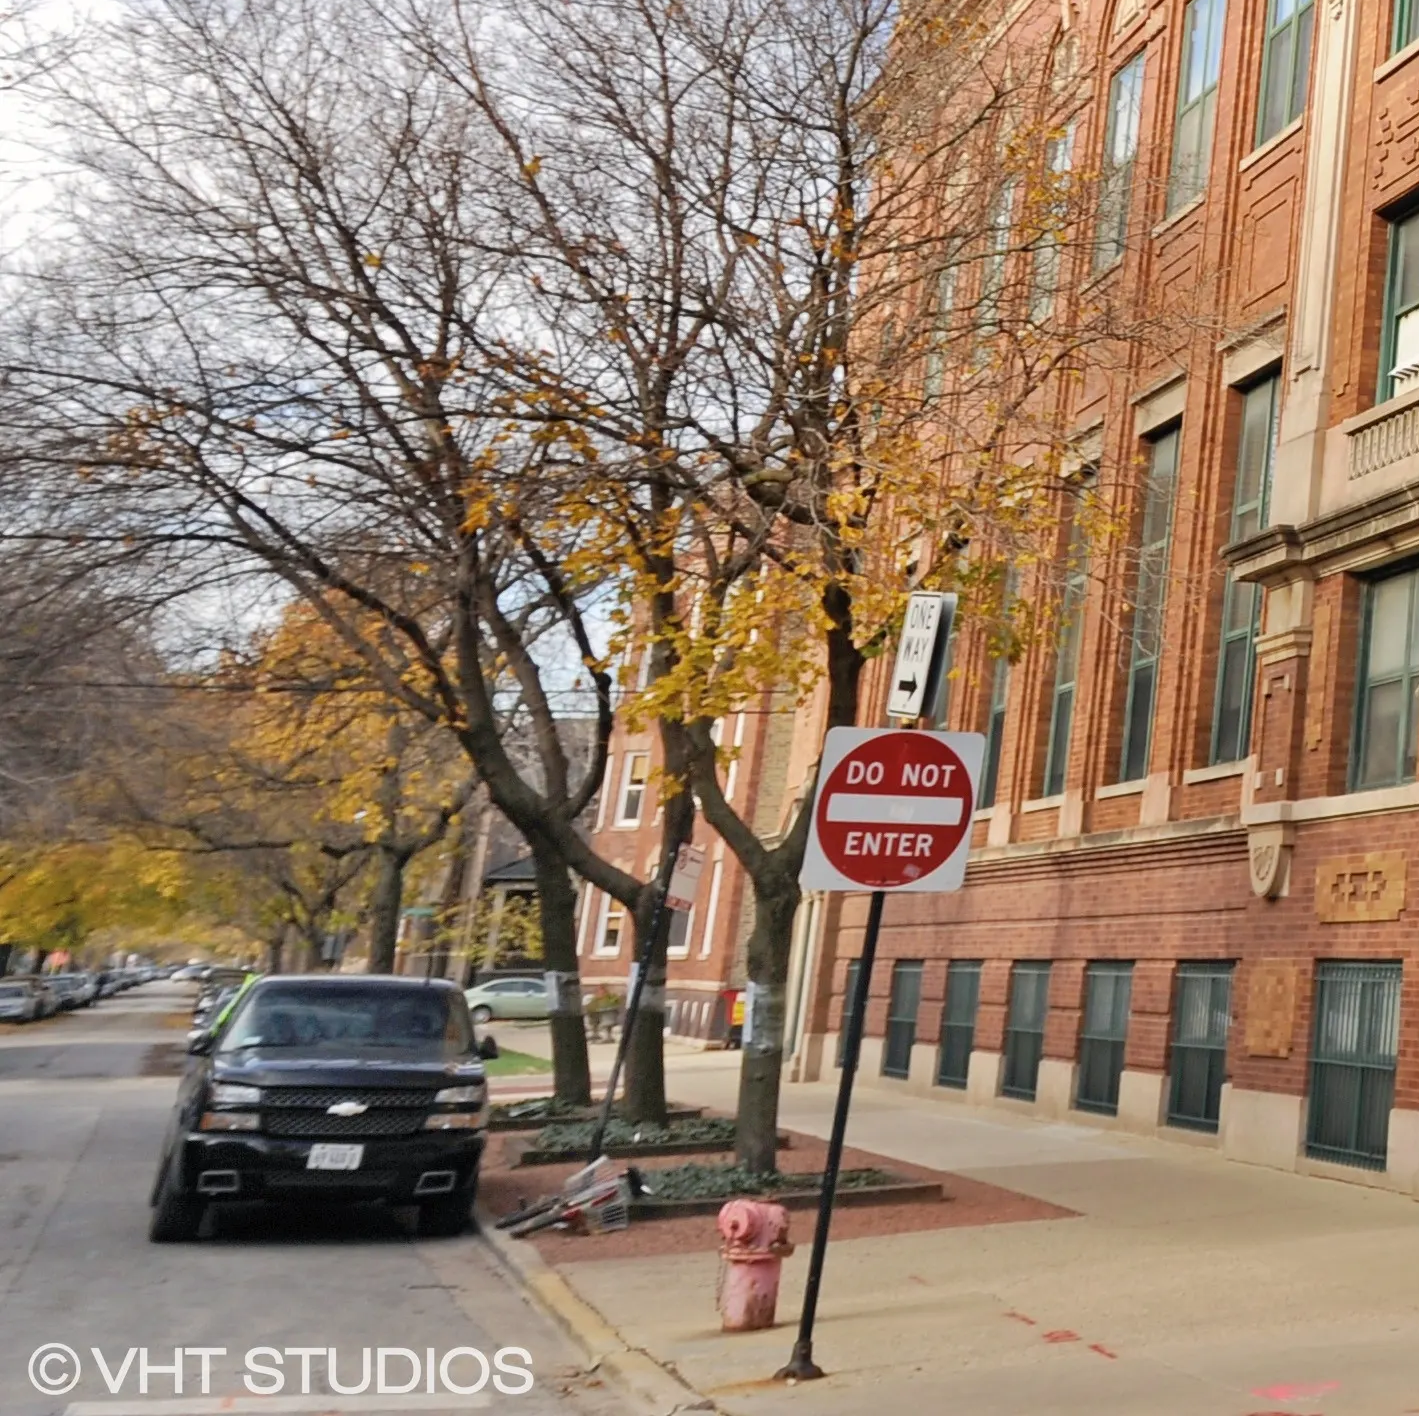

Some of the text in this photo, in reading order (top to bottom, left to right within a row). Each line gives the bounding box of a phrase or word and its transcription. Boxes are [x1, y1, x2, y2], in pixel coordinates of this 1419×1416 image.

[911, 603, 935, 630] ONE
[903, 636, 929, 662] WAY
[846, 760, 957, 788] DO NOT
[844, 831, 934, 857] ENTER
